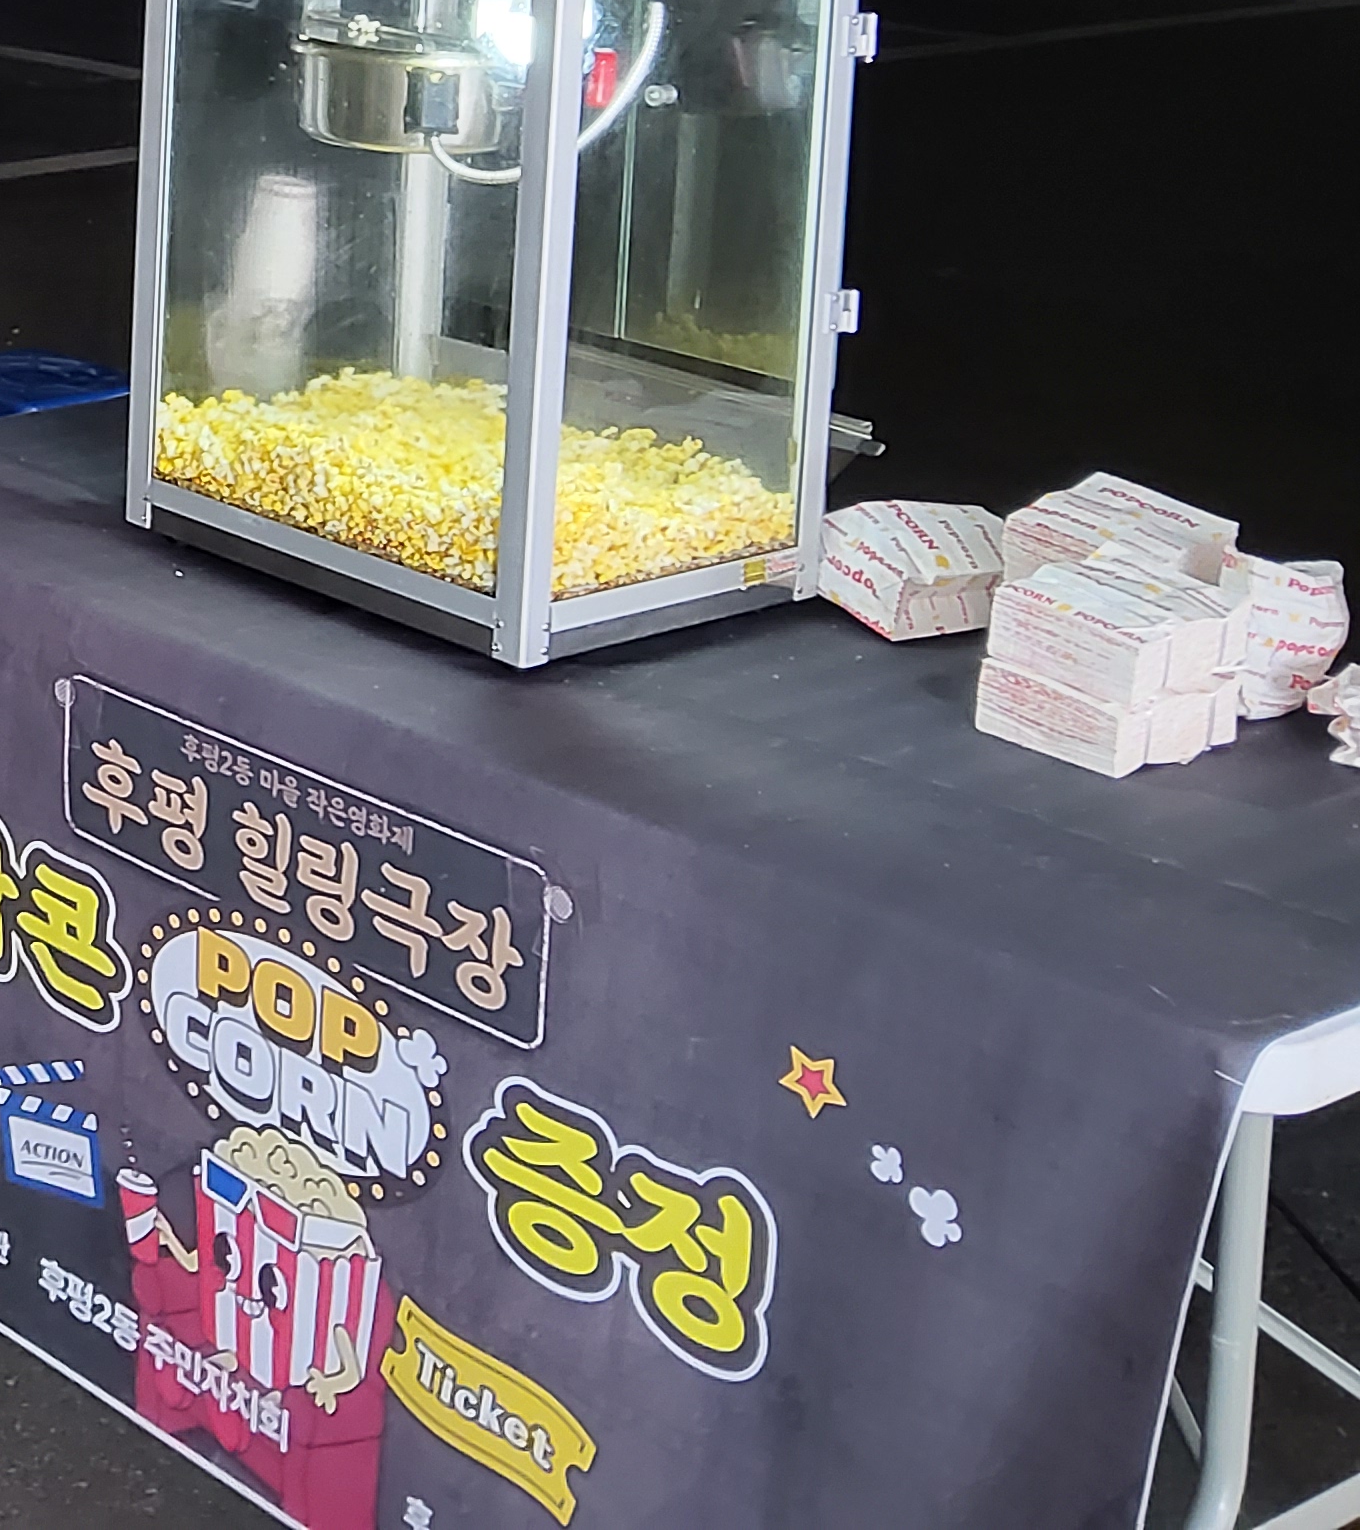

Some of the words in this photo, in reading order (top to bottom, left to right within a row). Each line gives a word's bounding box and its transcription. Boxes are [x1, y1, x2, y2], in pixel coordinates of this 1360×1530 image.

[885, 501, 939, 550] PCORN
[1098, 487, 1199, 529] POPCORN
[1073, 611, 1148, 644] POPCRN
[180, 733, 254, 786] 후평2동
[260, 769, 301, 808] 마을
[306, 787, 414, 856] 작은영화제
[81, 738, 209, 871] 후평
[232, 800, 525, 1012] 힐링극장
[196, 926, 381, 1072] POP
[21, 1139, 85, 1169] ACTION
[165, 993, 411, 1179] CORN
[483, 1100, 751, 1354] 증정
[38, 1257, 141, 1352] 후평2동
[143, 1323, 291, 1454] 주민자치회
[414, 1339, 557, 1475] Ticket
